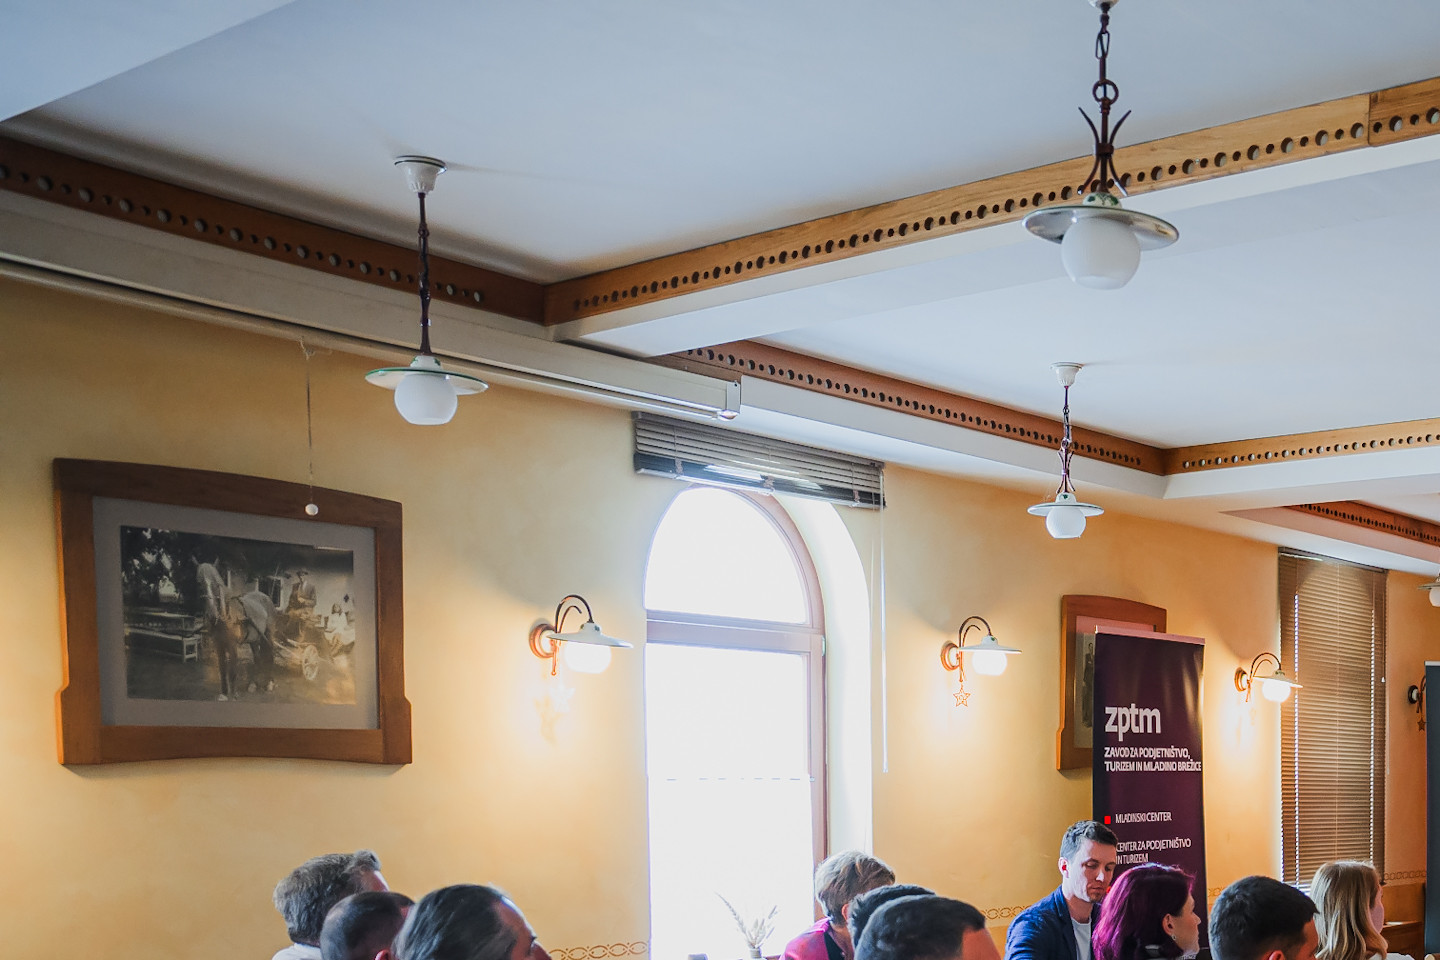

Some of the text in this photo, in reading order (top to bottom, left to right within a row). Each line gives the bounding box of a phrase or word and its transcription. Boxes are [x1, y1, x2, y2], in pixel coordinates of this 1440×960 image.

[1104, 703, 1161, 741] zptm
[1104, 745, 1190, 759] ZAVOD ZA PODJETNIŠTVO,
[1104, 761, 1135, 771] TURIZEM
[1136, 761, 1143, 771] IN
[1143, 761, 1177, 771] MLADINO
[1146, 812, 1172, 822] CENTER
[1116, 841, 1137, 852] CENTER
[1137, 841, 1146, 851] ZA
